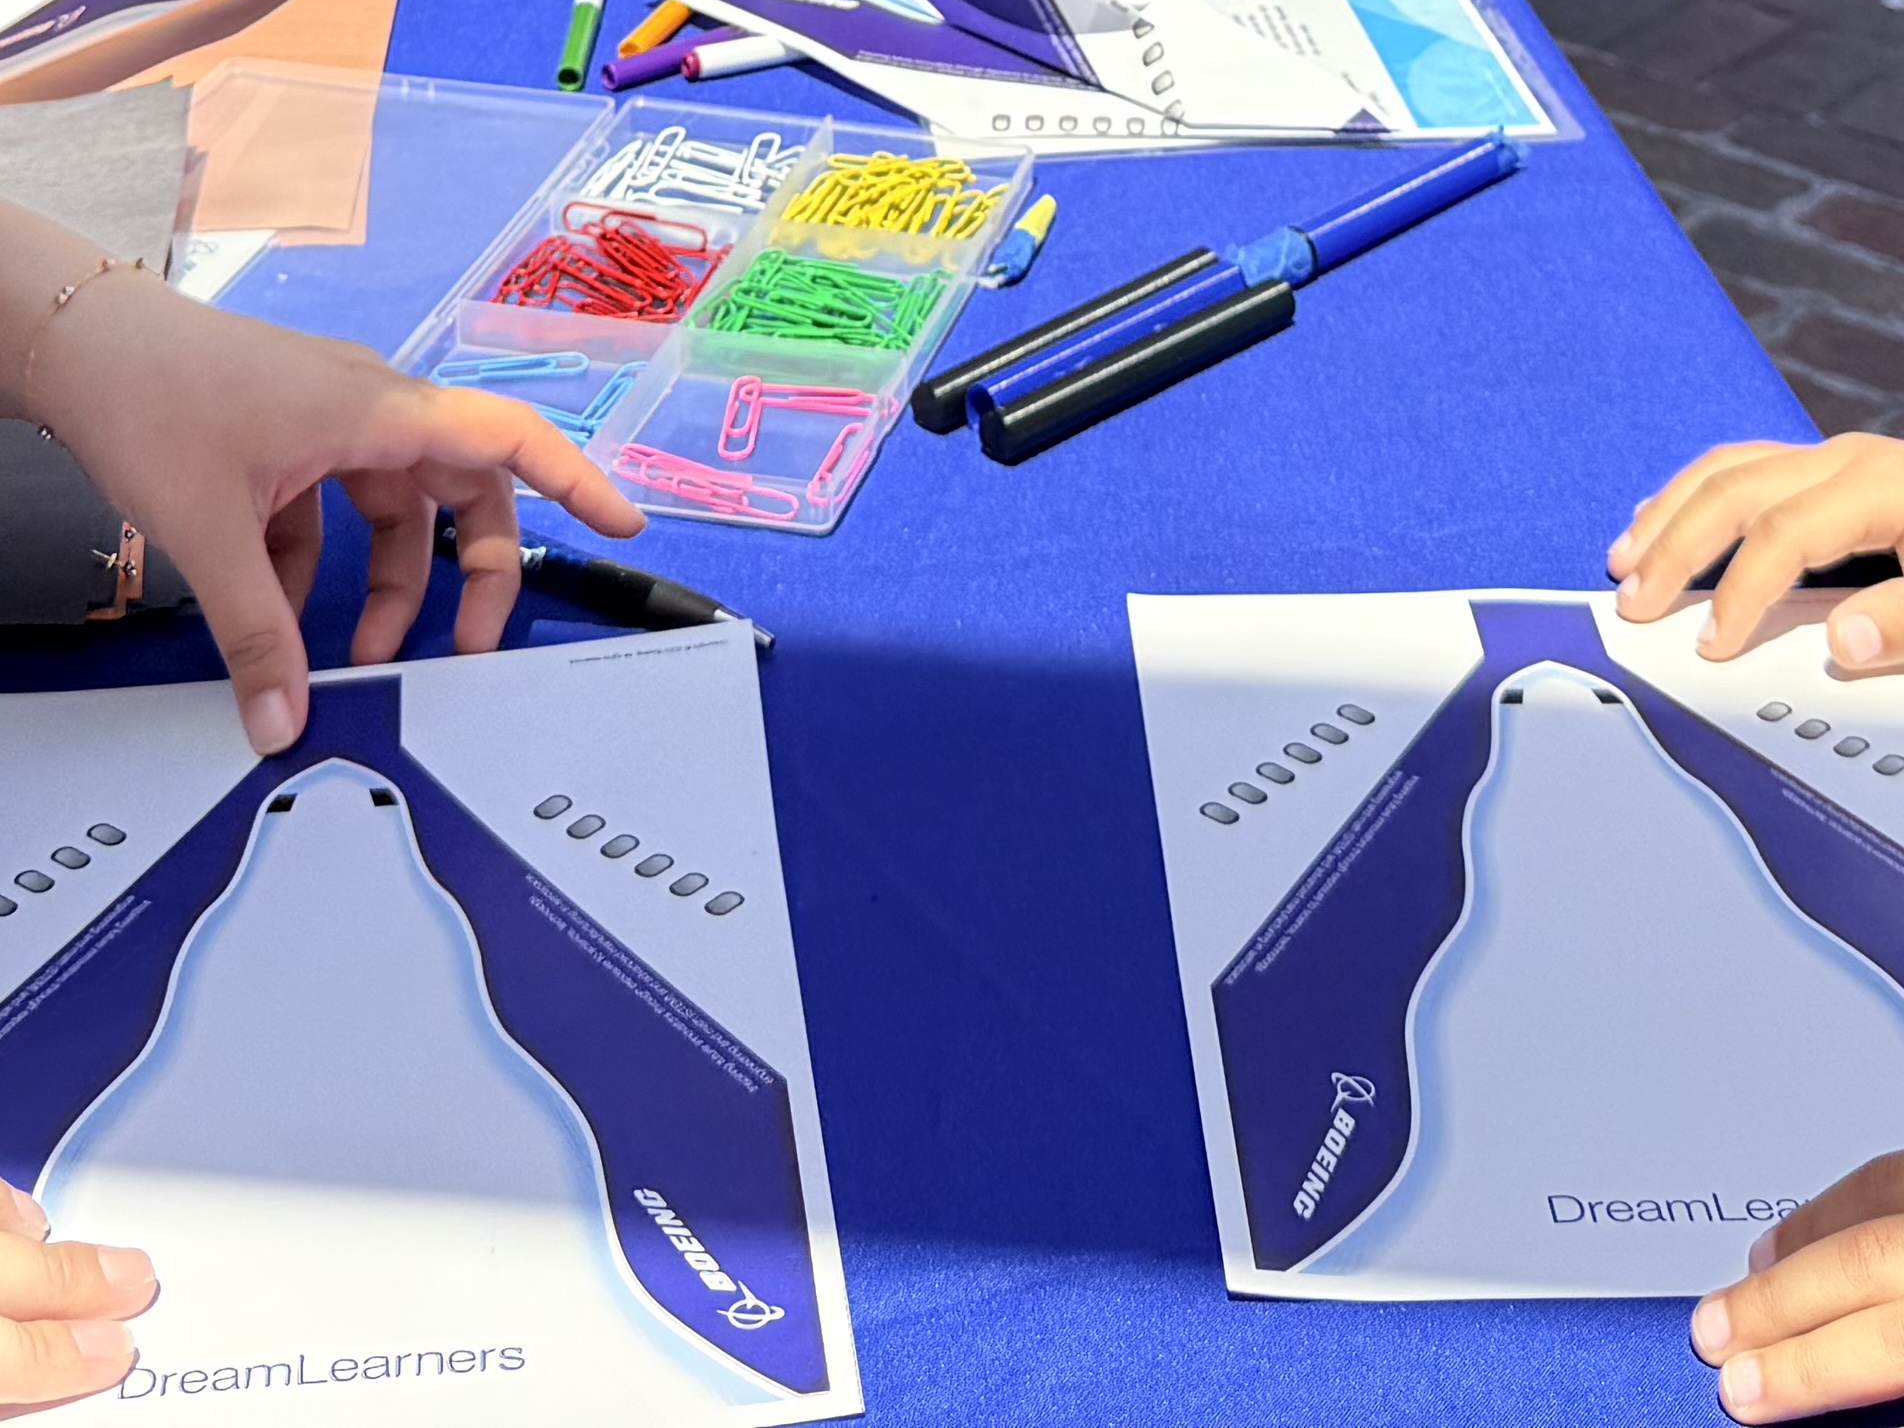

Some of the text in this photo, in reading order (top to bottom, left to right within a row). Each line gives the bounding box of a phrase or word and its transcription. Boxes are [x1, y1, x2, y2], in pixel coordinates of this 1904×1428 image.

[1293, 1107, 1356, 1220] BOEING
[633, 1188, 738, 1292] BOEING
[1546, 1192, 1810, 1224] DreamLea
[117, 1345, 526, 1401] DreamLearners
